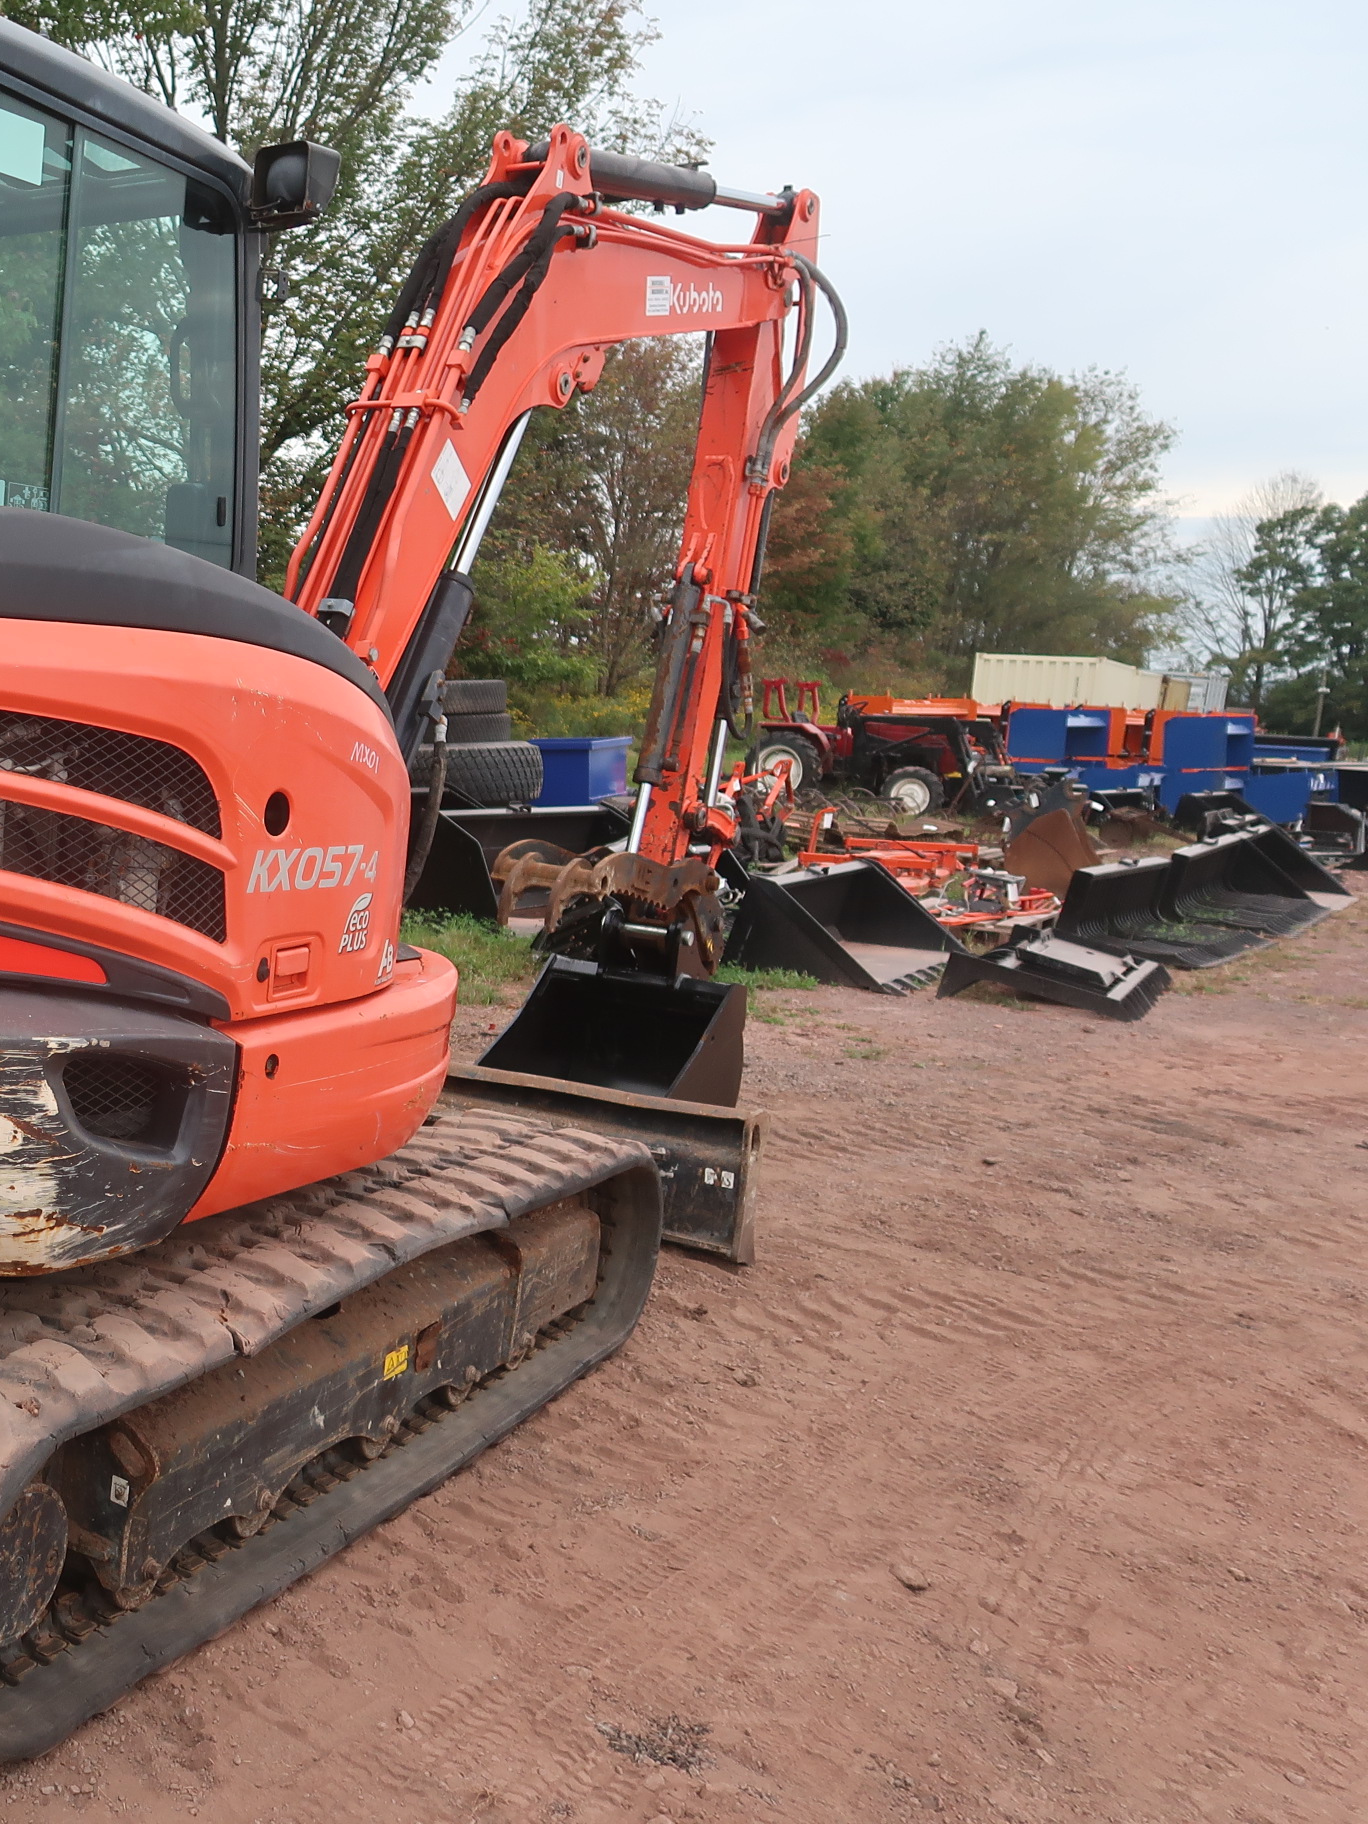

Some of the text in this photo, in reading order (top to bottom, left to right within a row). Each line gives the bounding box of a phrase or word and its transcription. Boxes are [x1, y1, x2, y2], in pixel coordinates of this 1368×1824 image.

[669, 281, 723, 314] Kubota
[246, 844, 379, 894] KX057-4
[348, 910, 369, 932] eco
[338, 930, 368, 954] PLUS
